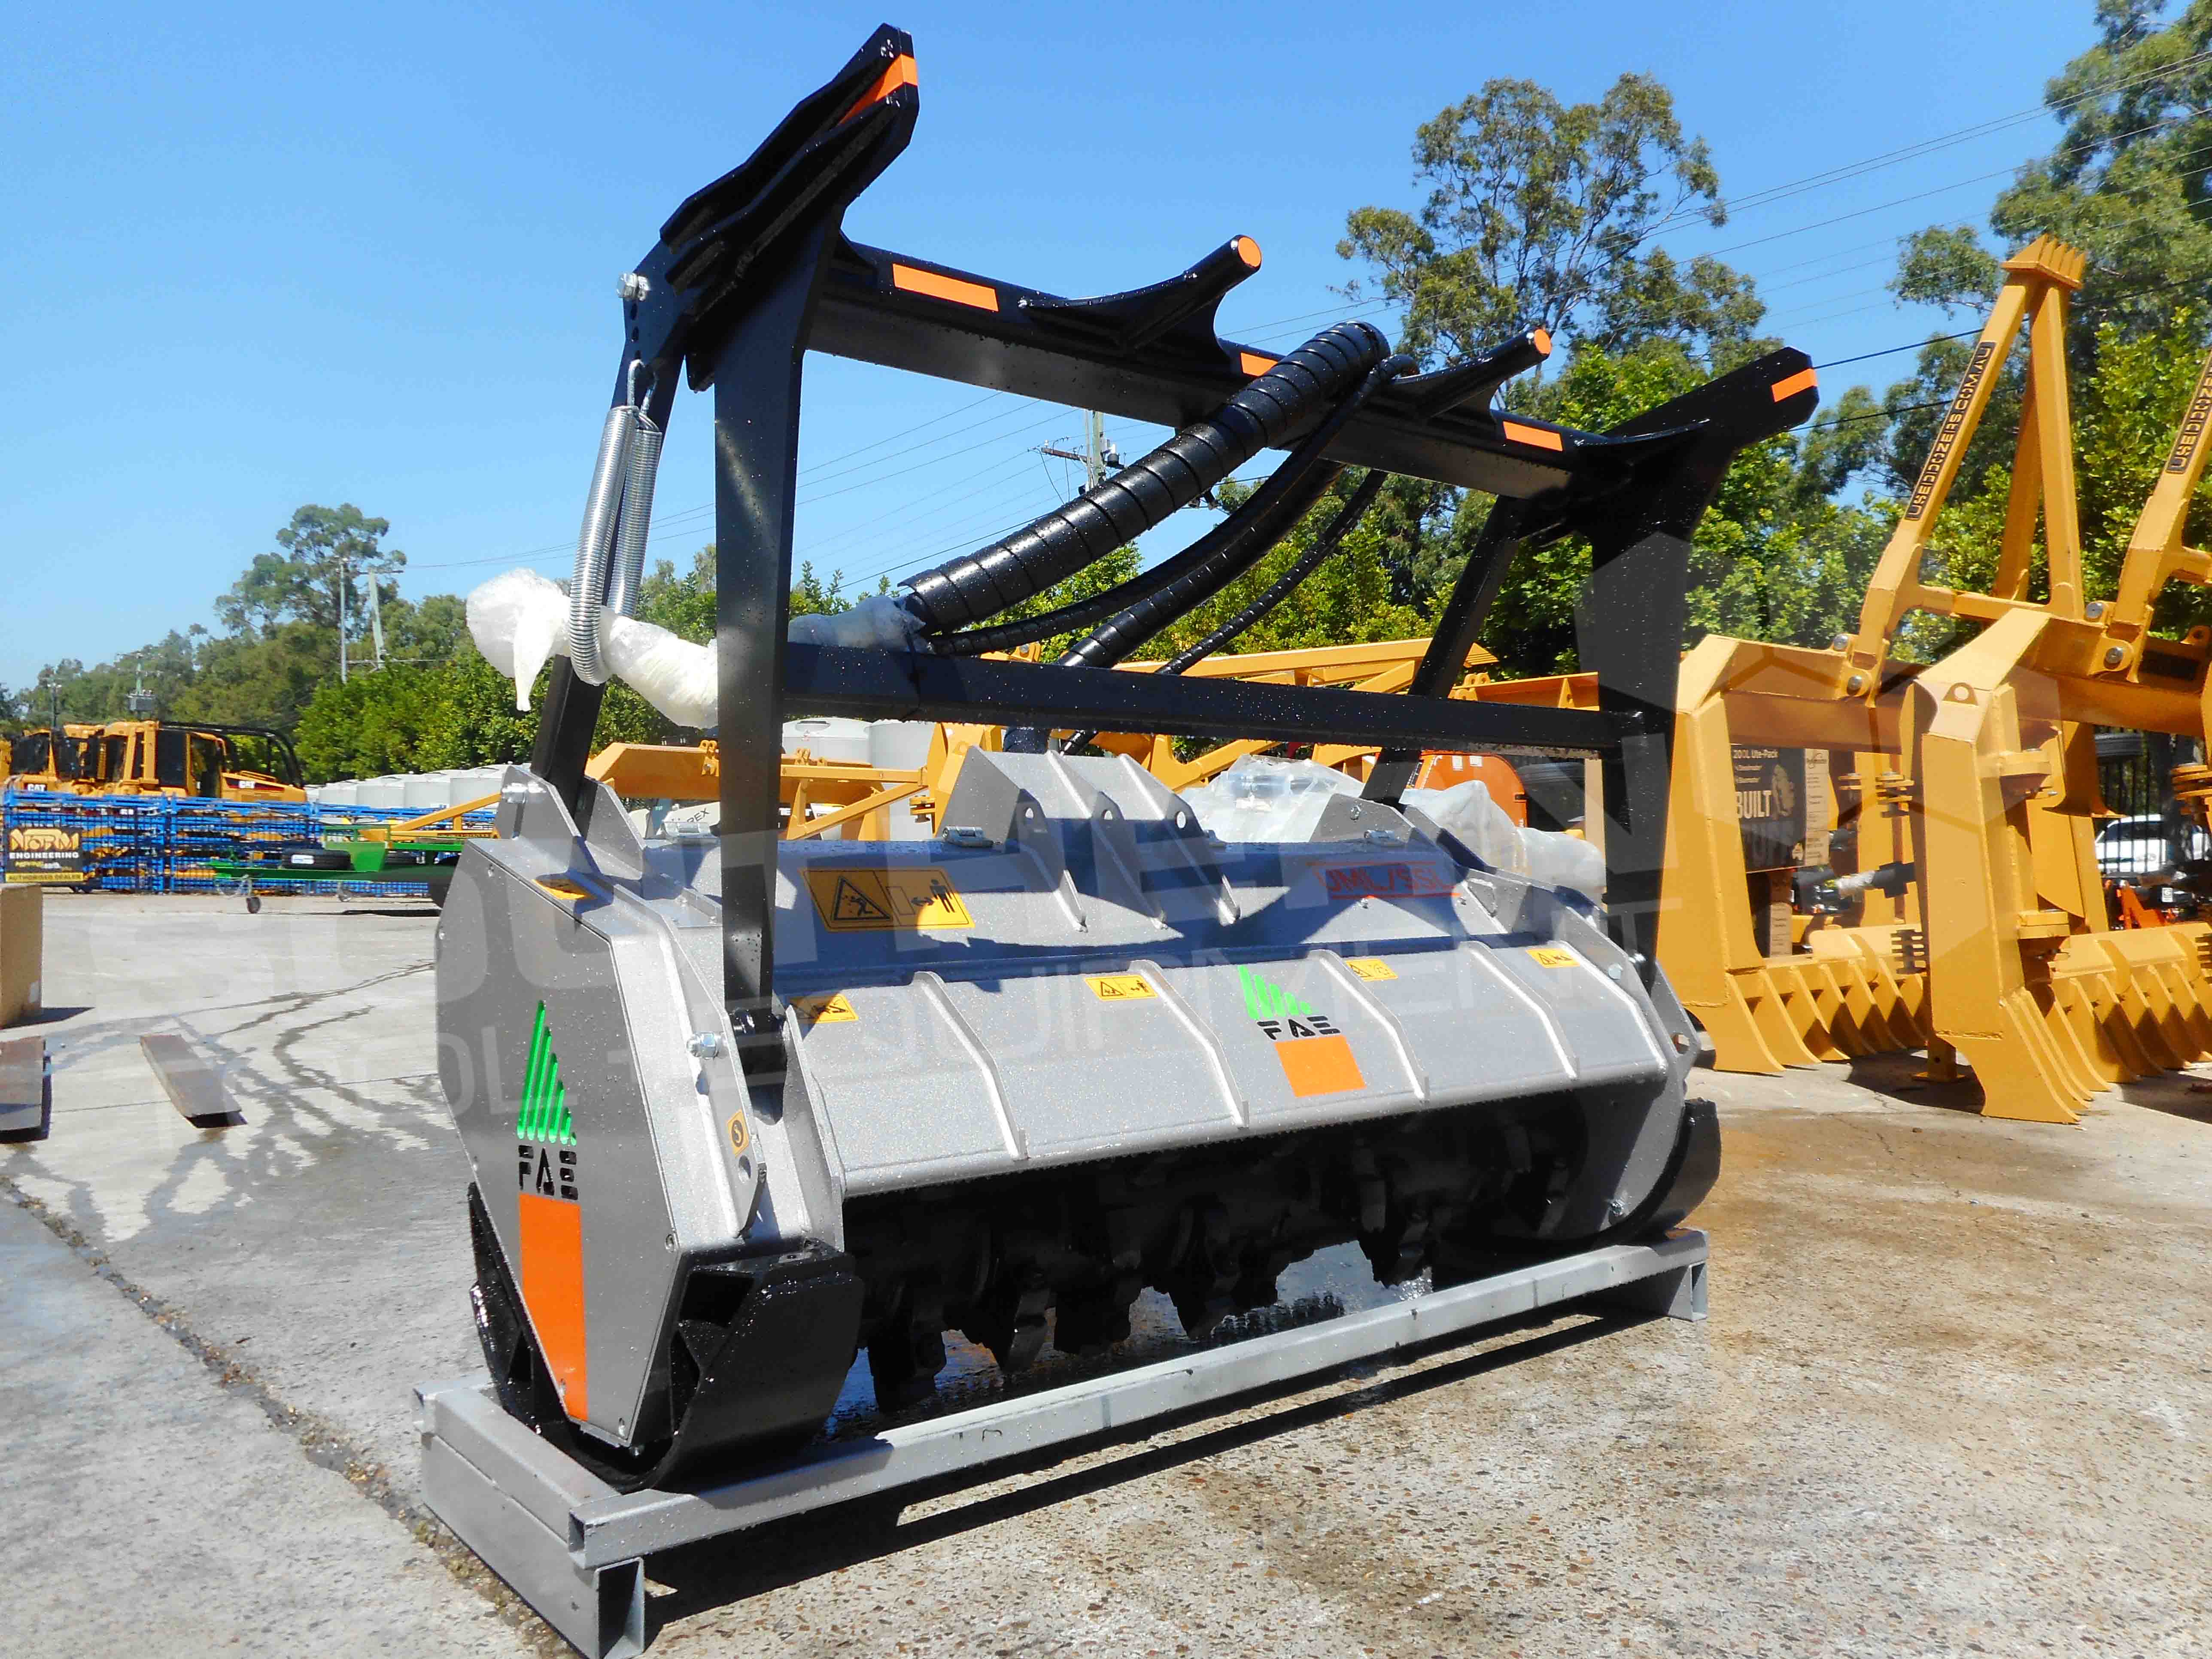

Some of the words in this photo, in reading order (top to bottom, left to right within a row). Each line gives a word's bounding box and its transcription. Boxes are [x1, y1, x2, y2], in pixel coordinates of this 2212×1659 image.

[27, 784, 46, 792] CAT
[1256, 1016, 1340, 1039] FAE
[518, 1145, 578, 1201] FAE
